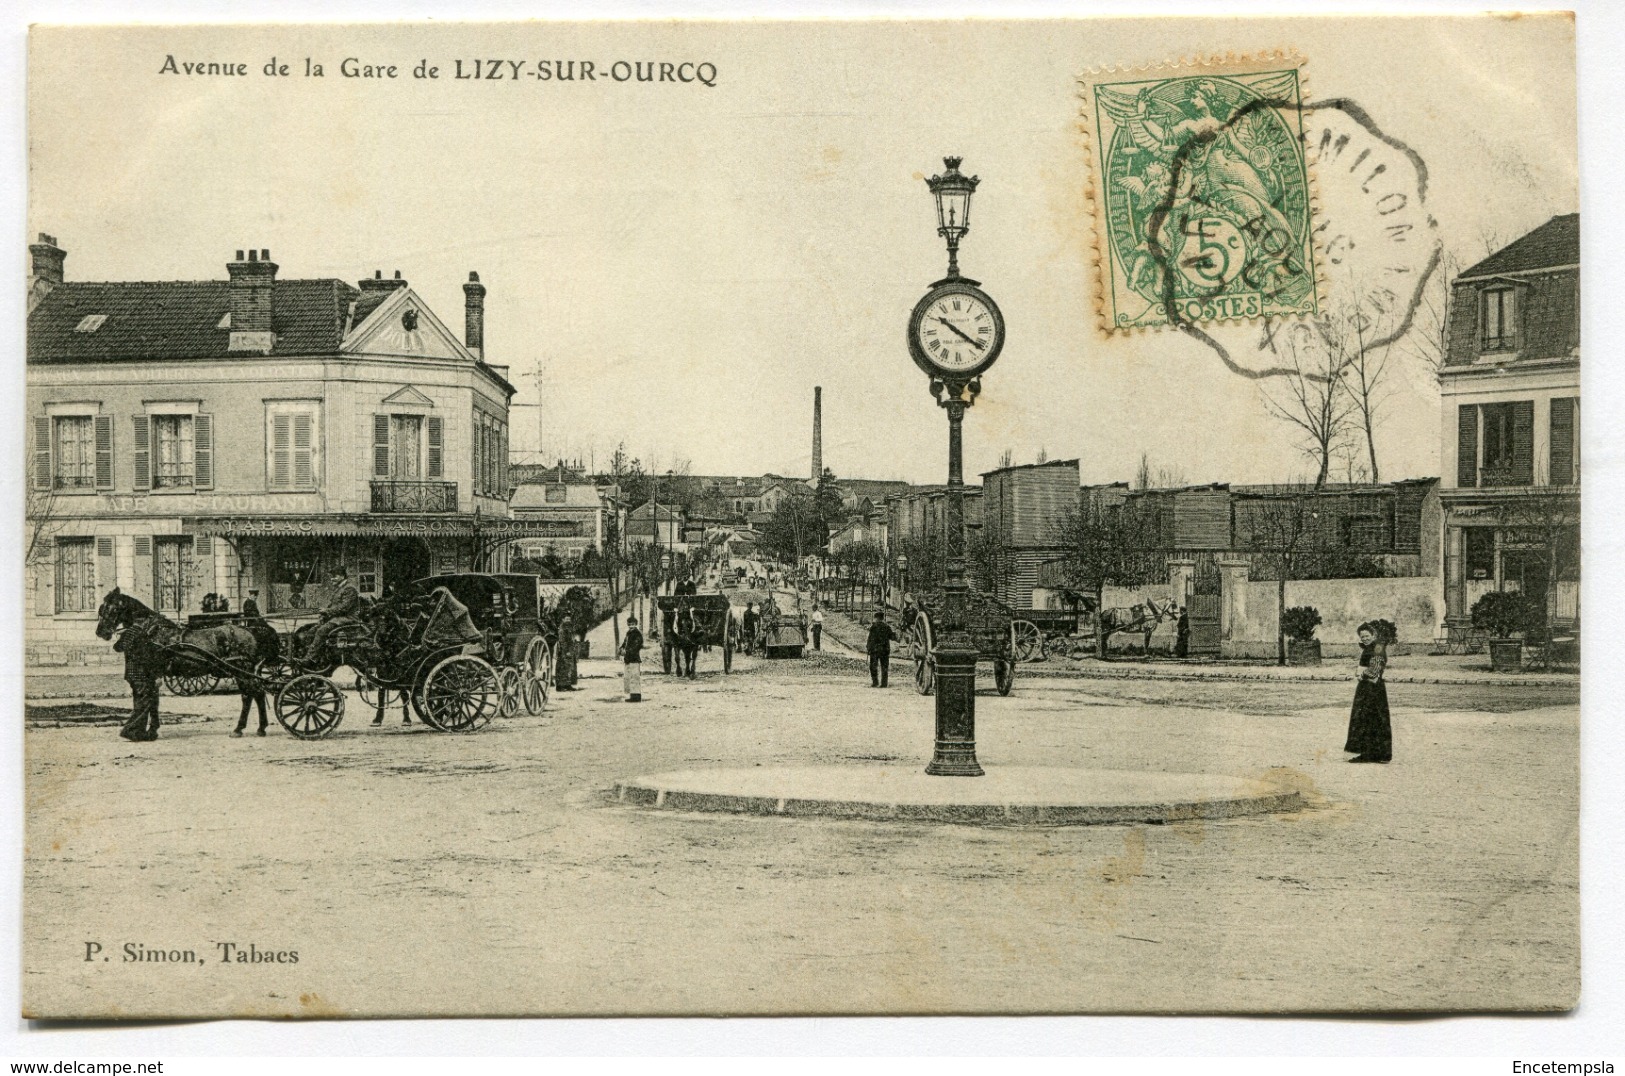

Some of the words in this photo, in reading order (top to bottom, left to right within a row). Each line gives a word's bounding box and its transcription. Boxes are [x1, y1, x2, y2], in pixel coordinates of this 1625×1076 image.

[158, 55, 247, 76] Avenue
[264, 57, 289, 77] de
[305, 57, 324, 77] la
[340, 58, 398, 79] Gare
[413, 59, 439, 79] de
[455, 60, 717, 87] LIZY-SUR-OURCQ
[221, 519, 314, 533] TABAC
[84, 941, 109, 963] P.
[123, 942, 205, 966] Simon,
[216, 942, 300, 964] Tabacs
